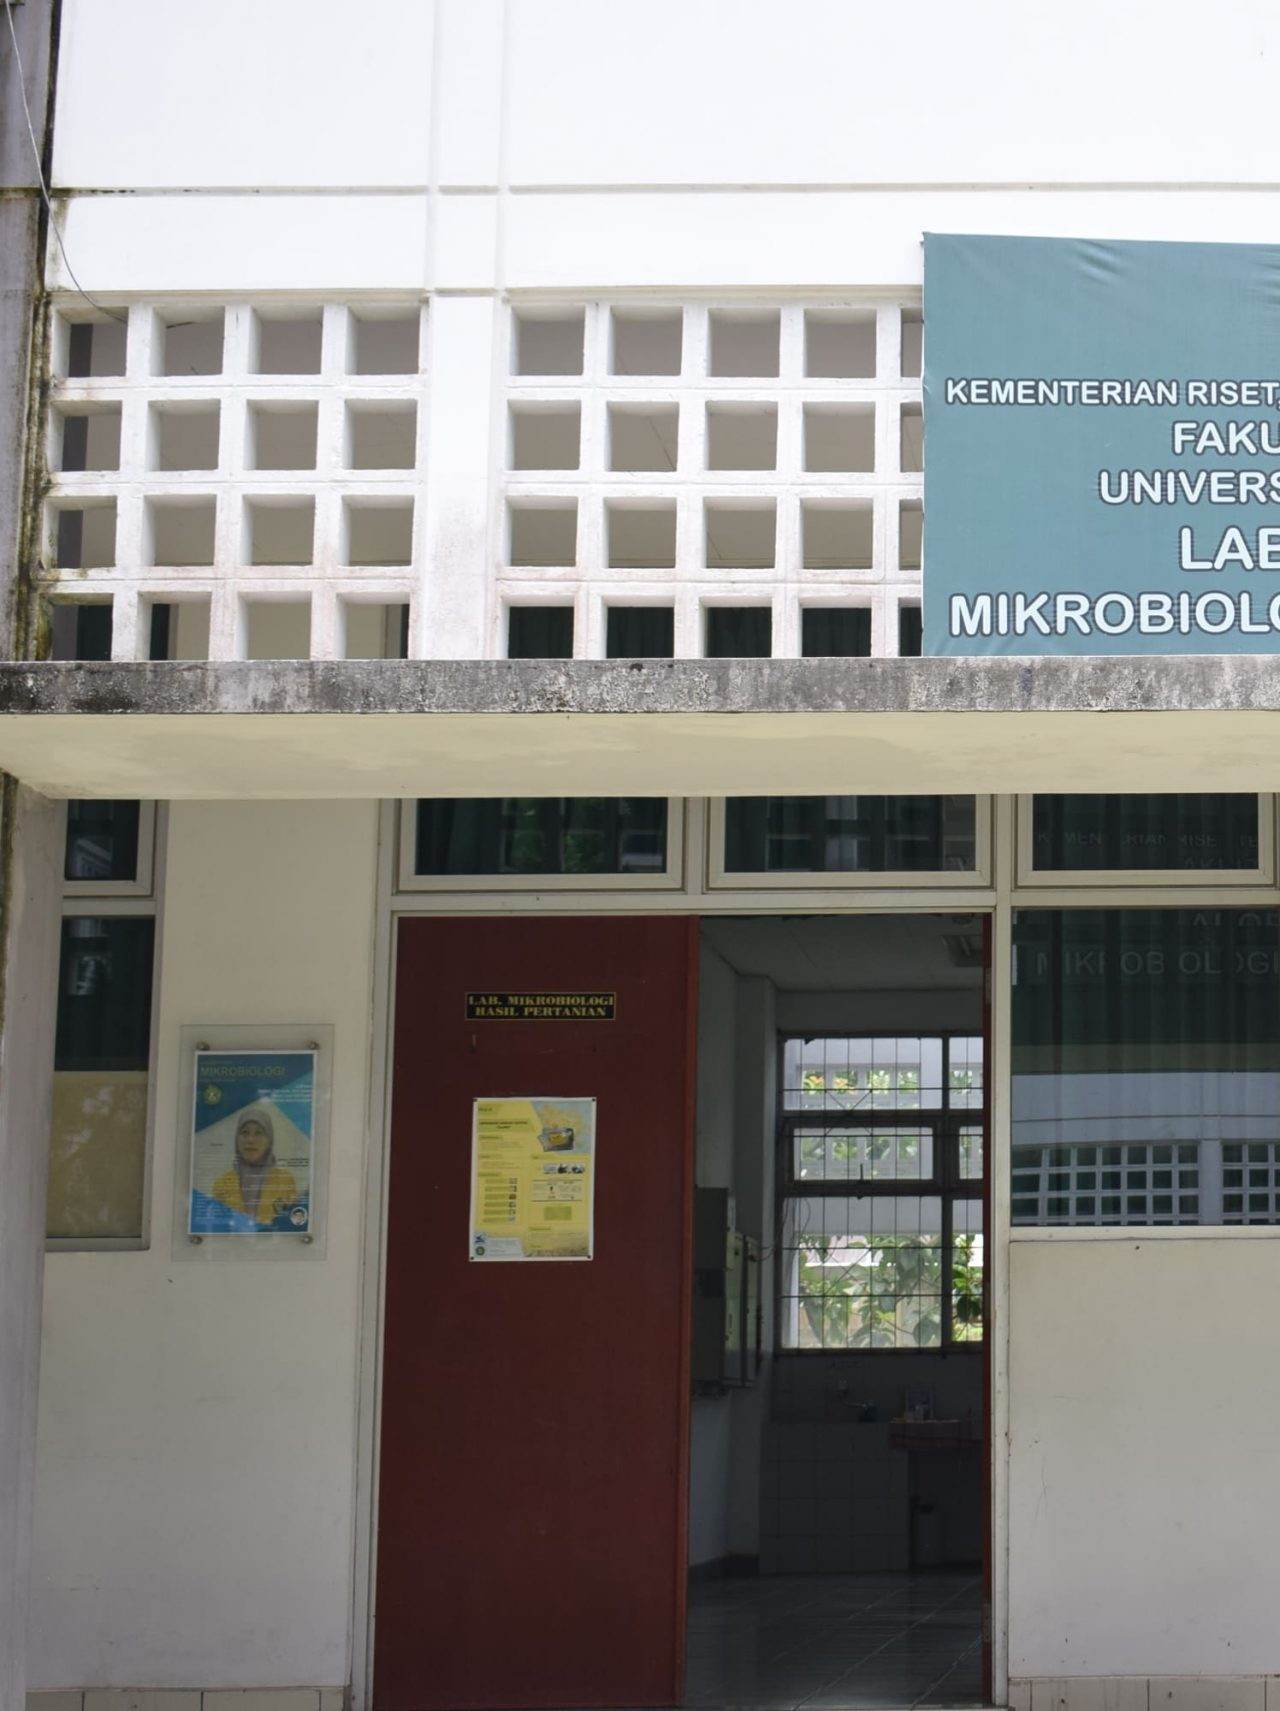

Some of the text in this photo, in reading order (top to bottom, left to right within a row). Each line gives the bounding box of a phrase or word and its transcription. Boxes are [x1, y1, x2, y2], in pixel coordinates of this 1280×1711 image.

[945, 378, 1178, 405] KEMENTERIAN
[469, 995, 614, 1006] LAB. MIKROBIOLOGI
[475, 1006, 607, 1017] HASIL PERTANIAN
